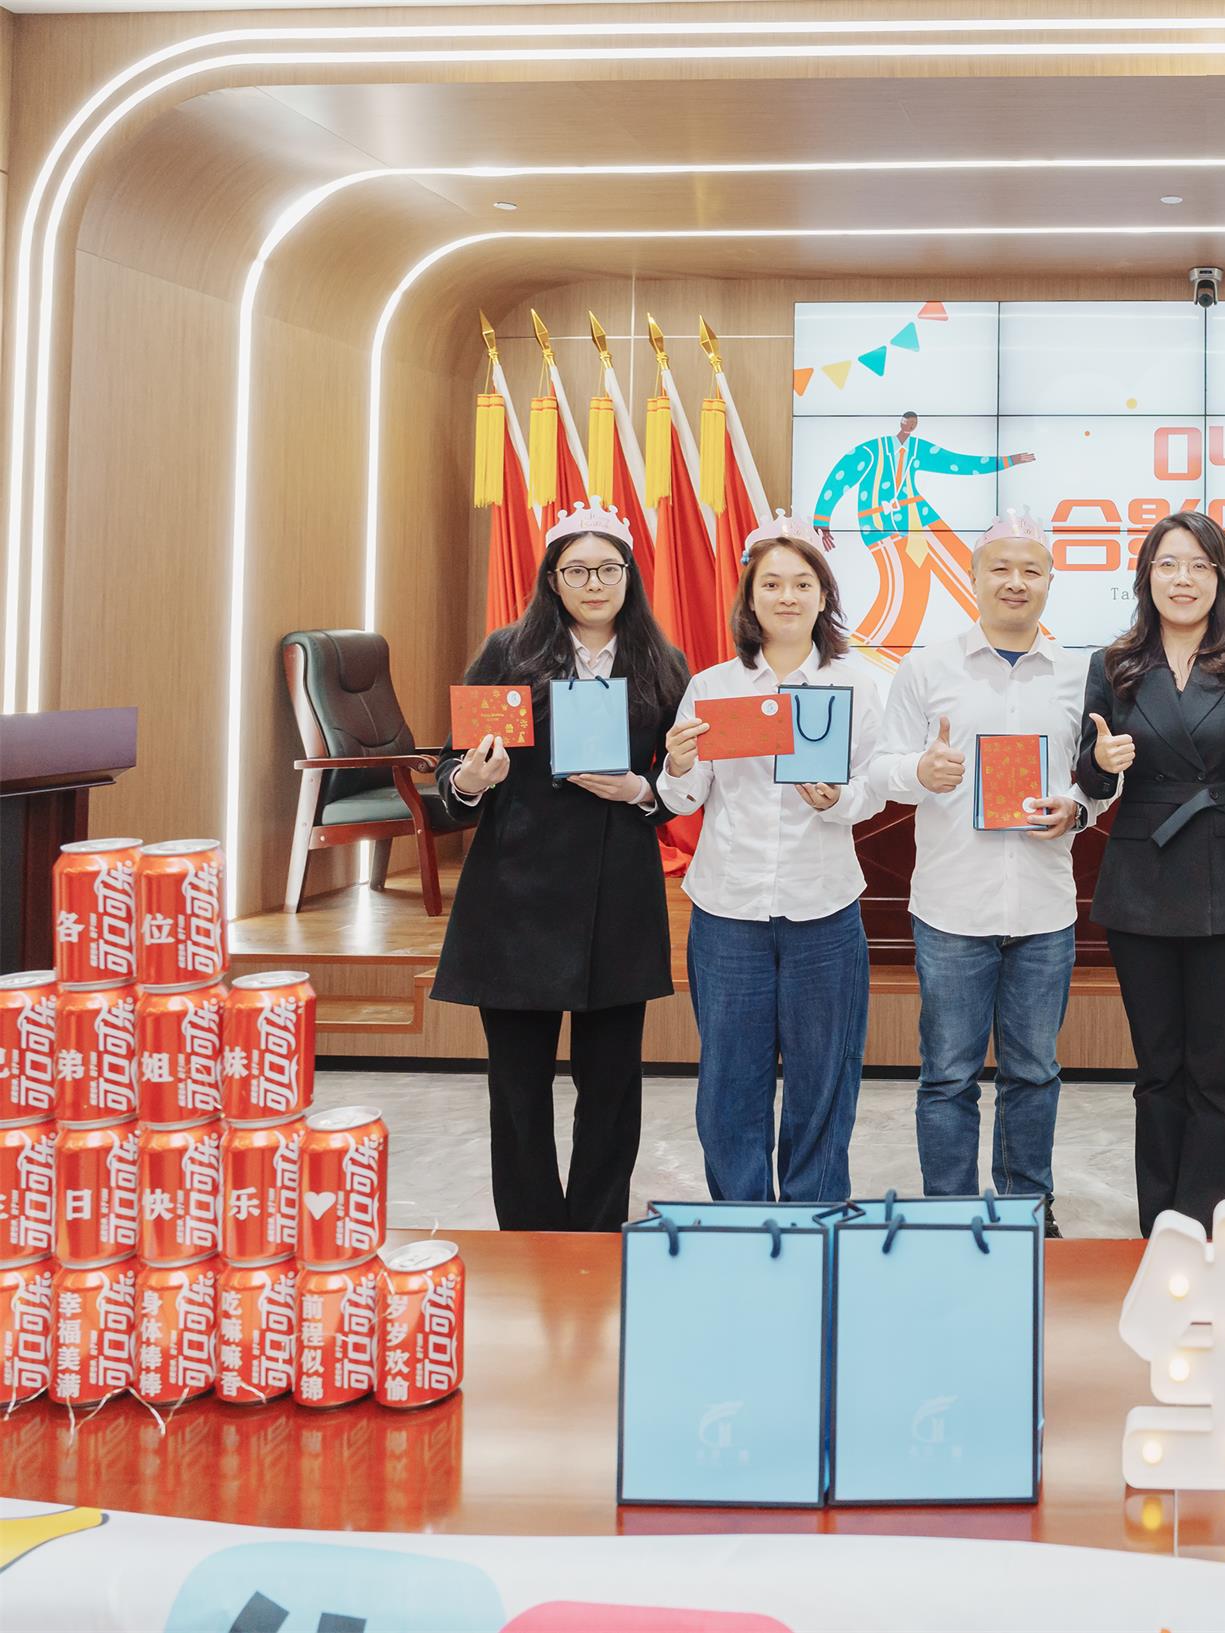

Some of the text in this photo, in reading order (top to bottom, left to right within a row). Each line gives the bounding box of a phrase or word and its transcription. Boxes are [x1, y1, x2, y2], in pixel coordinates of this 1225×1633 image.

[1110, 587, 1136, 601] Ta
[57, 910, 85, 943] 各
[141, 912, 175, 946] 位
[181, 859, 222, 975] 可口可乐
[57, 1048, 85, 1081] 弟
[141, 1051, 174, 1084] 姐
[222, 1045, 250, 1080] 妹
[257, 995, 297, 1112] 可口可乐
[65, 1188, 93, 1221] 日
[142, 1187, 175, 1221] 快
[181, 1131, 220, 1248] 可口可乐
[227, 1186, 262, 1221] 乐
[342, 1132, 379, 1251] 可口可乐
[56, 1291, 83, 1399] 幸福美满
[96, 1270, 136, 1387] 可口可乐
[139, 1290, 163, 1397] 身体棒棒
[176, 1270, 216, 1388] 可口可乐
[220, 1290, 243, 1397] 吃嘛嘛香
[301, 1294, 325, 1401] 前程似锦
[340, 1272, 377, 1390] 可口可乐
[384, 1294, 410, 1402] 岁岁欢愉
[421, 1272, 457, 1391] 可口可乐
